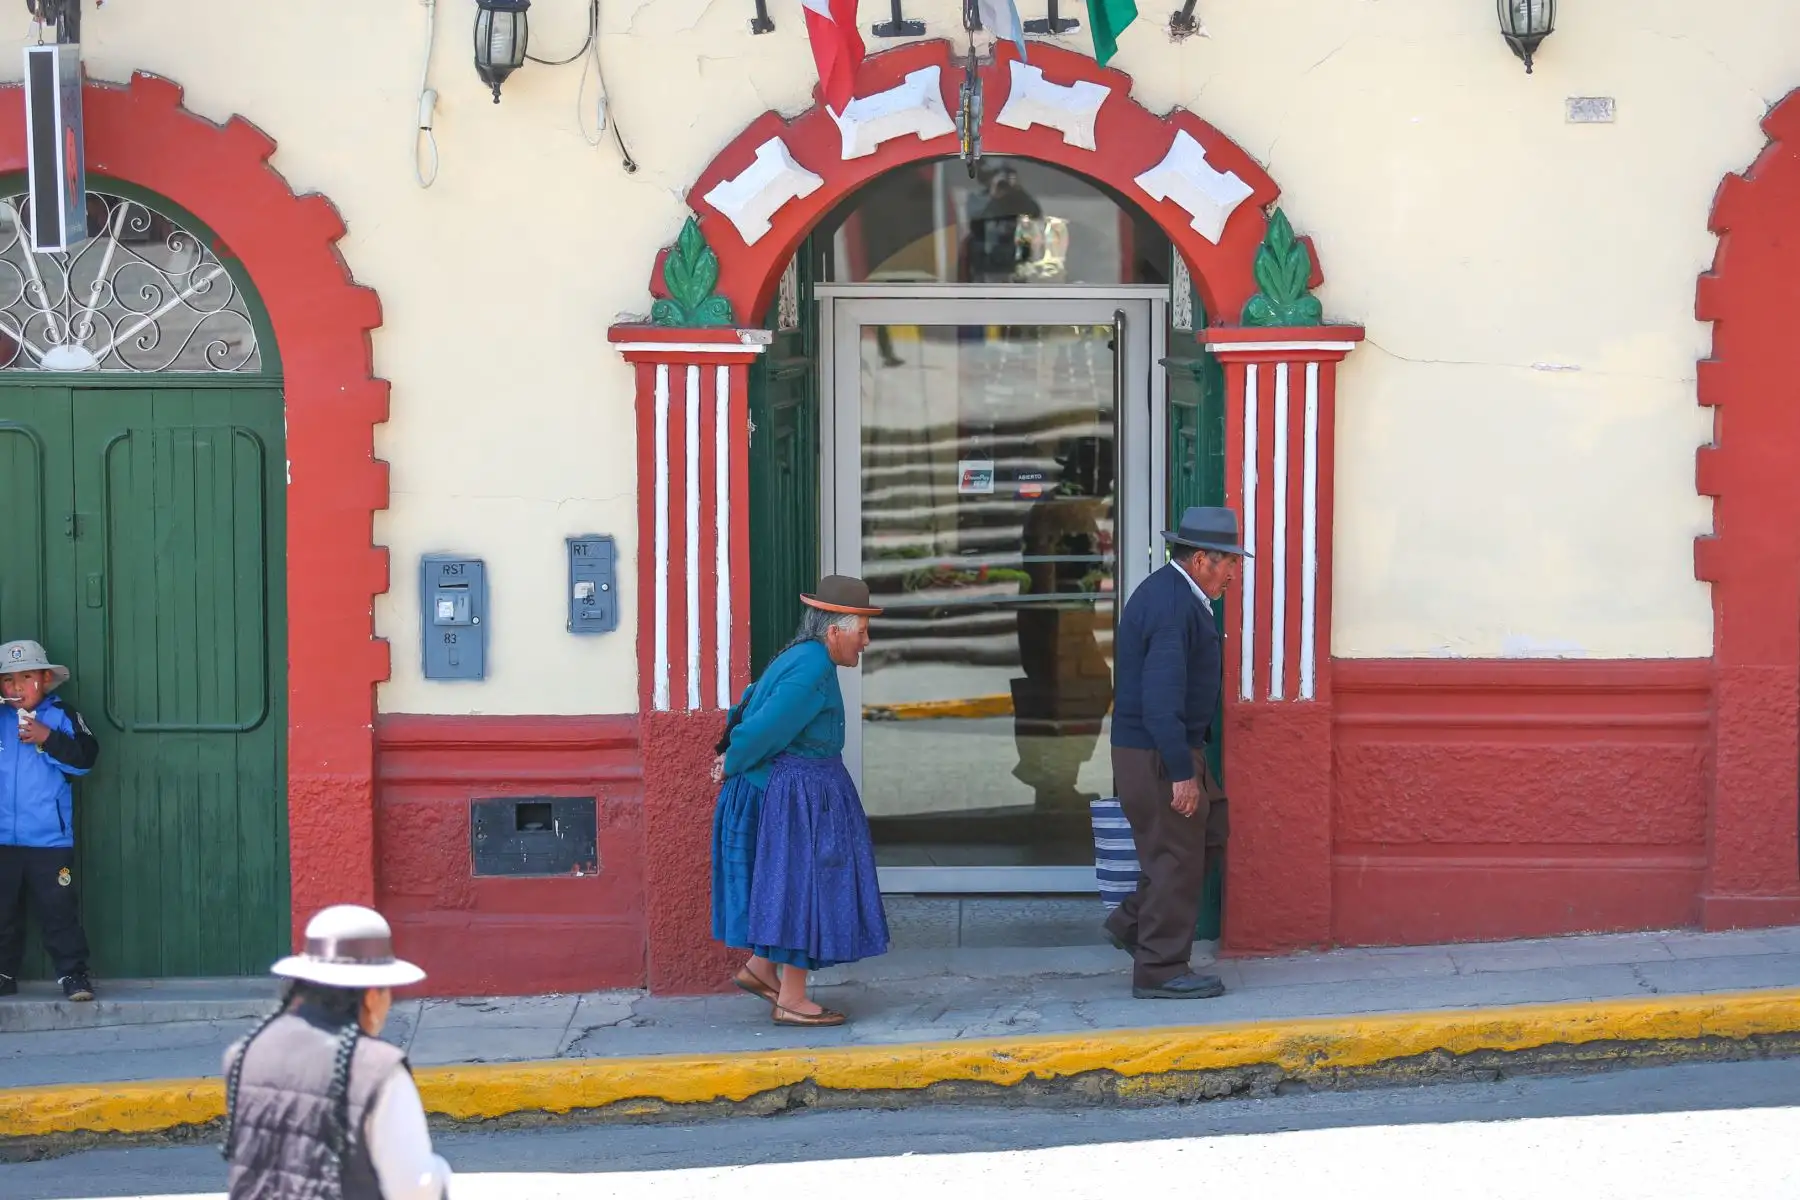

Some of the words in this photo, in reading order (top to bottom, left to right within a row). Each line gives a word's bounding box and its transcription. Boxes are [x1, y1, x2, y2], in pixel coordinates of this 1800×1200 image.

[573, 544, 588, 556] RT
[442, 563, 466, 575] RST
[444, 632, 457, 644] 83
